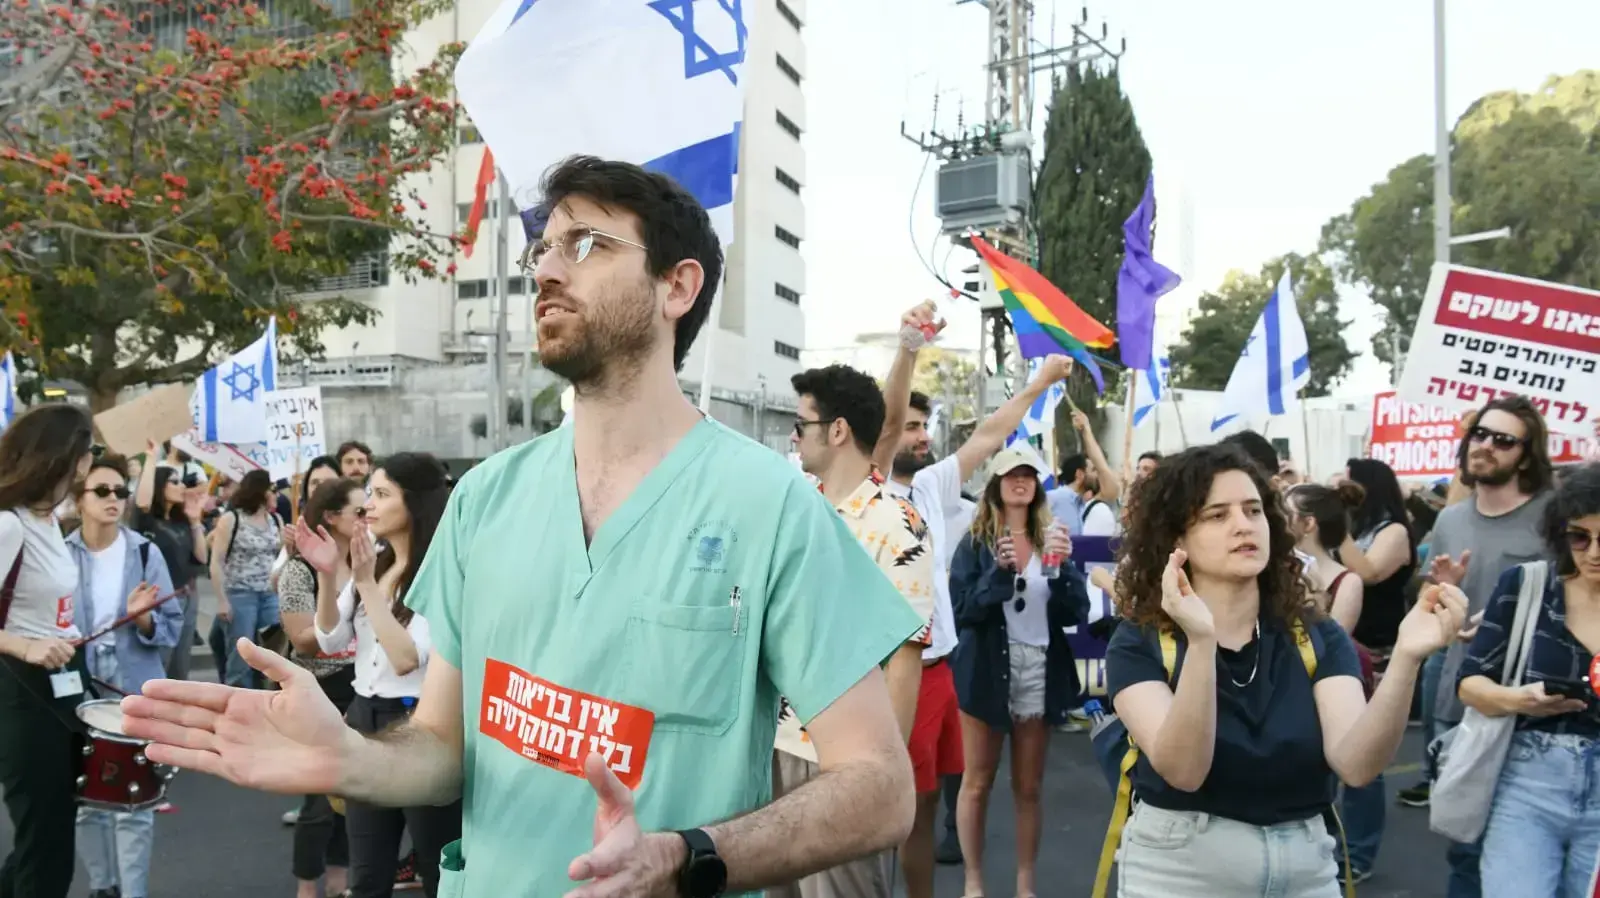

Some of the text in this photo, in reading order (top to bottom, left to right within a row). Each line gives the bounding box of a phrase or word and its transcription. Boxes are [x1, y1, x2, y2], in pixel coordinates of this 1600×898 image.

[1448, 290, 1540, 325] לשקם
[1442, 333, 1597, 373] פיזיותרפיסטים
[1458, 359, 1566, 392] נותנים גב
[1427, 377, 1589, 422] לדמרטיה
[1405, 425, 1455, 439] FOR
[506, 671, 620, 736] אין בריאות
[487, 696, 585, 759] דמוקרטיה
[588, 734, 633, 773] בלי
